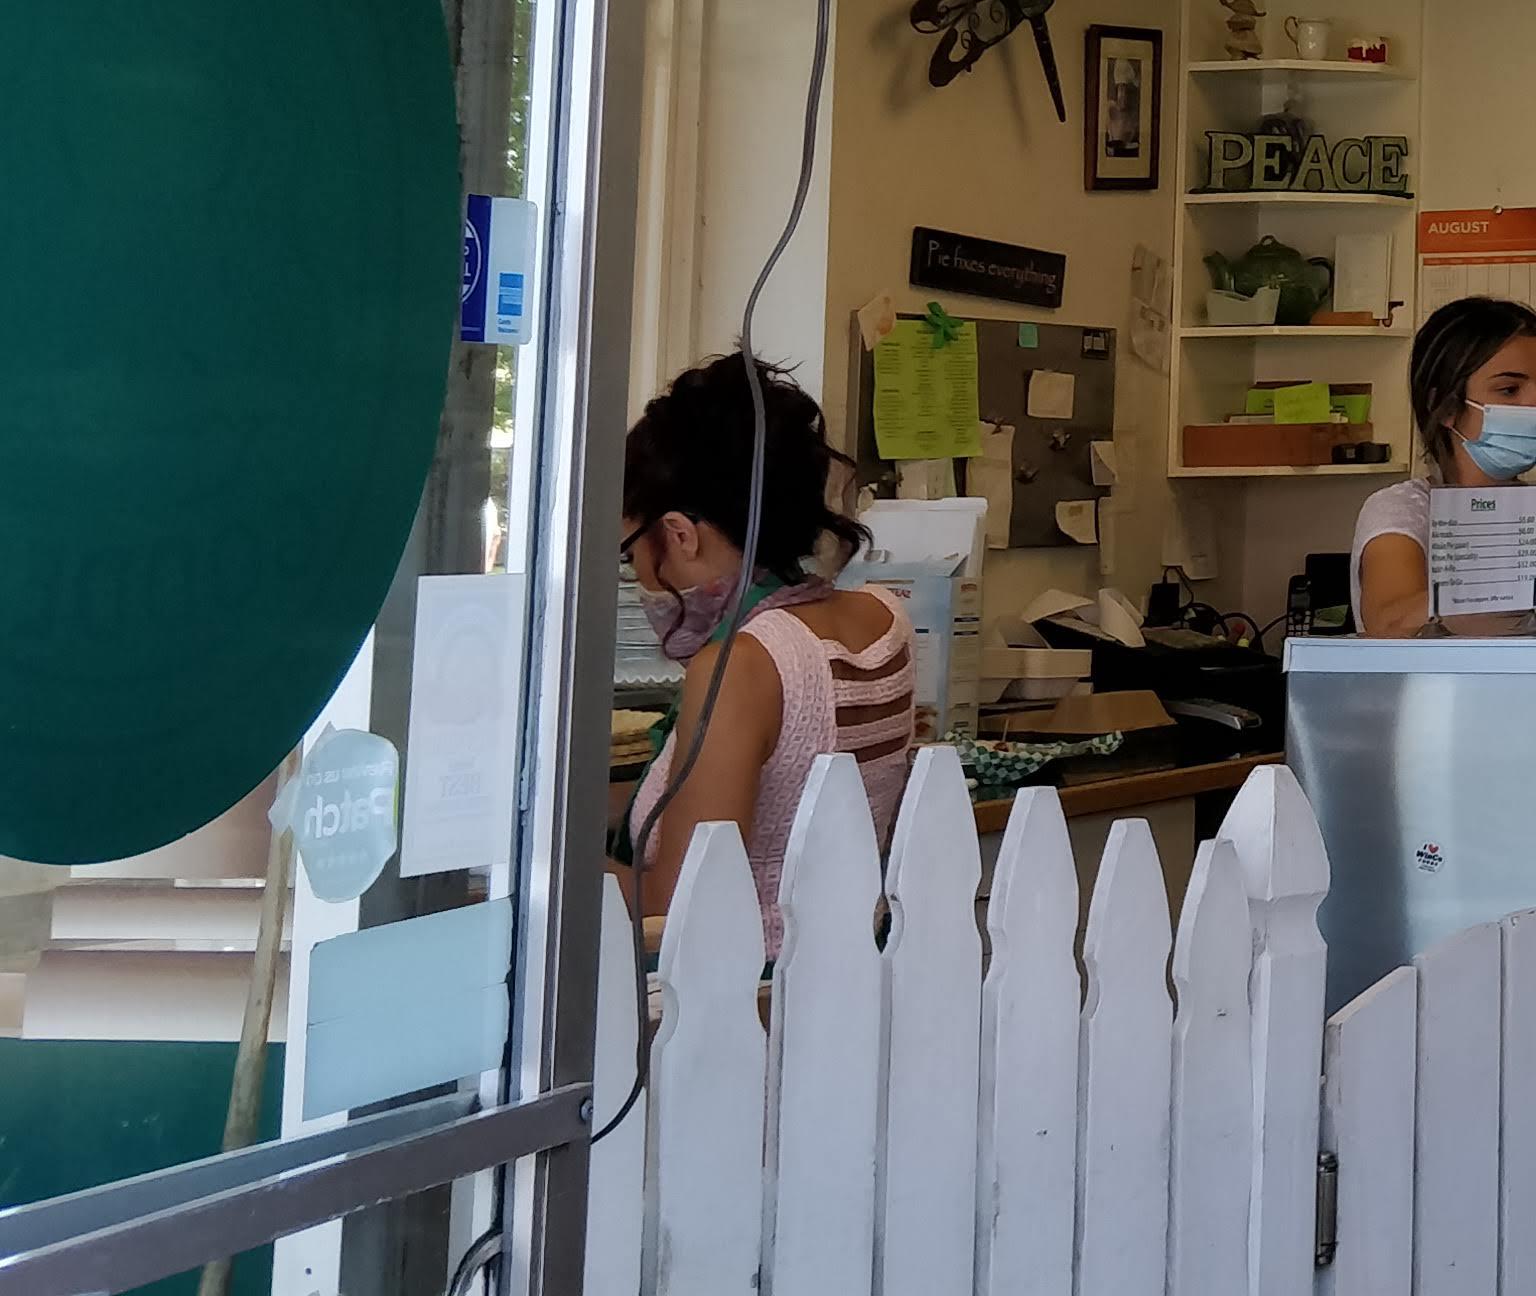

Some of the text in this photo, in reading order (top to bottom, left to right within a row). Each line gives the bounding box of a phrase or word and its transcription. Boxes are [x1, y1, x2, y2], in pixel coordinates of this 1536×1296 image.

[1206, 131, 1409, 192] PEACE
[1427, 220, 1490, 235] AUGUST
[927, 239, 949, 267] Pie
[988, 259, 1057, 295] everything
